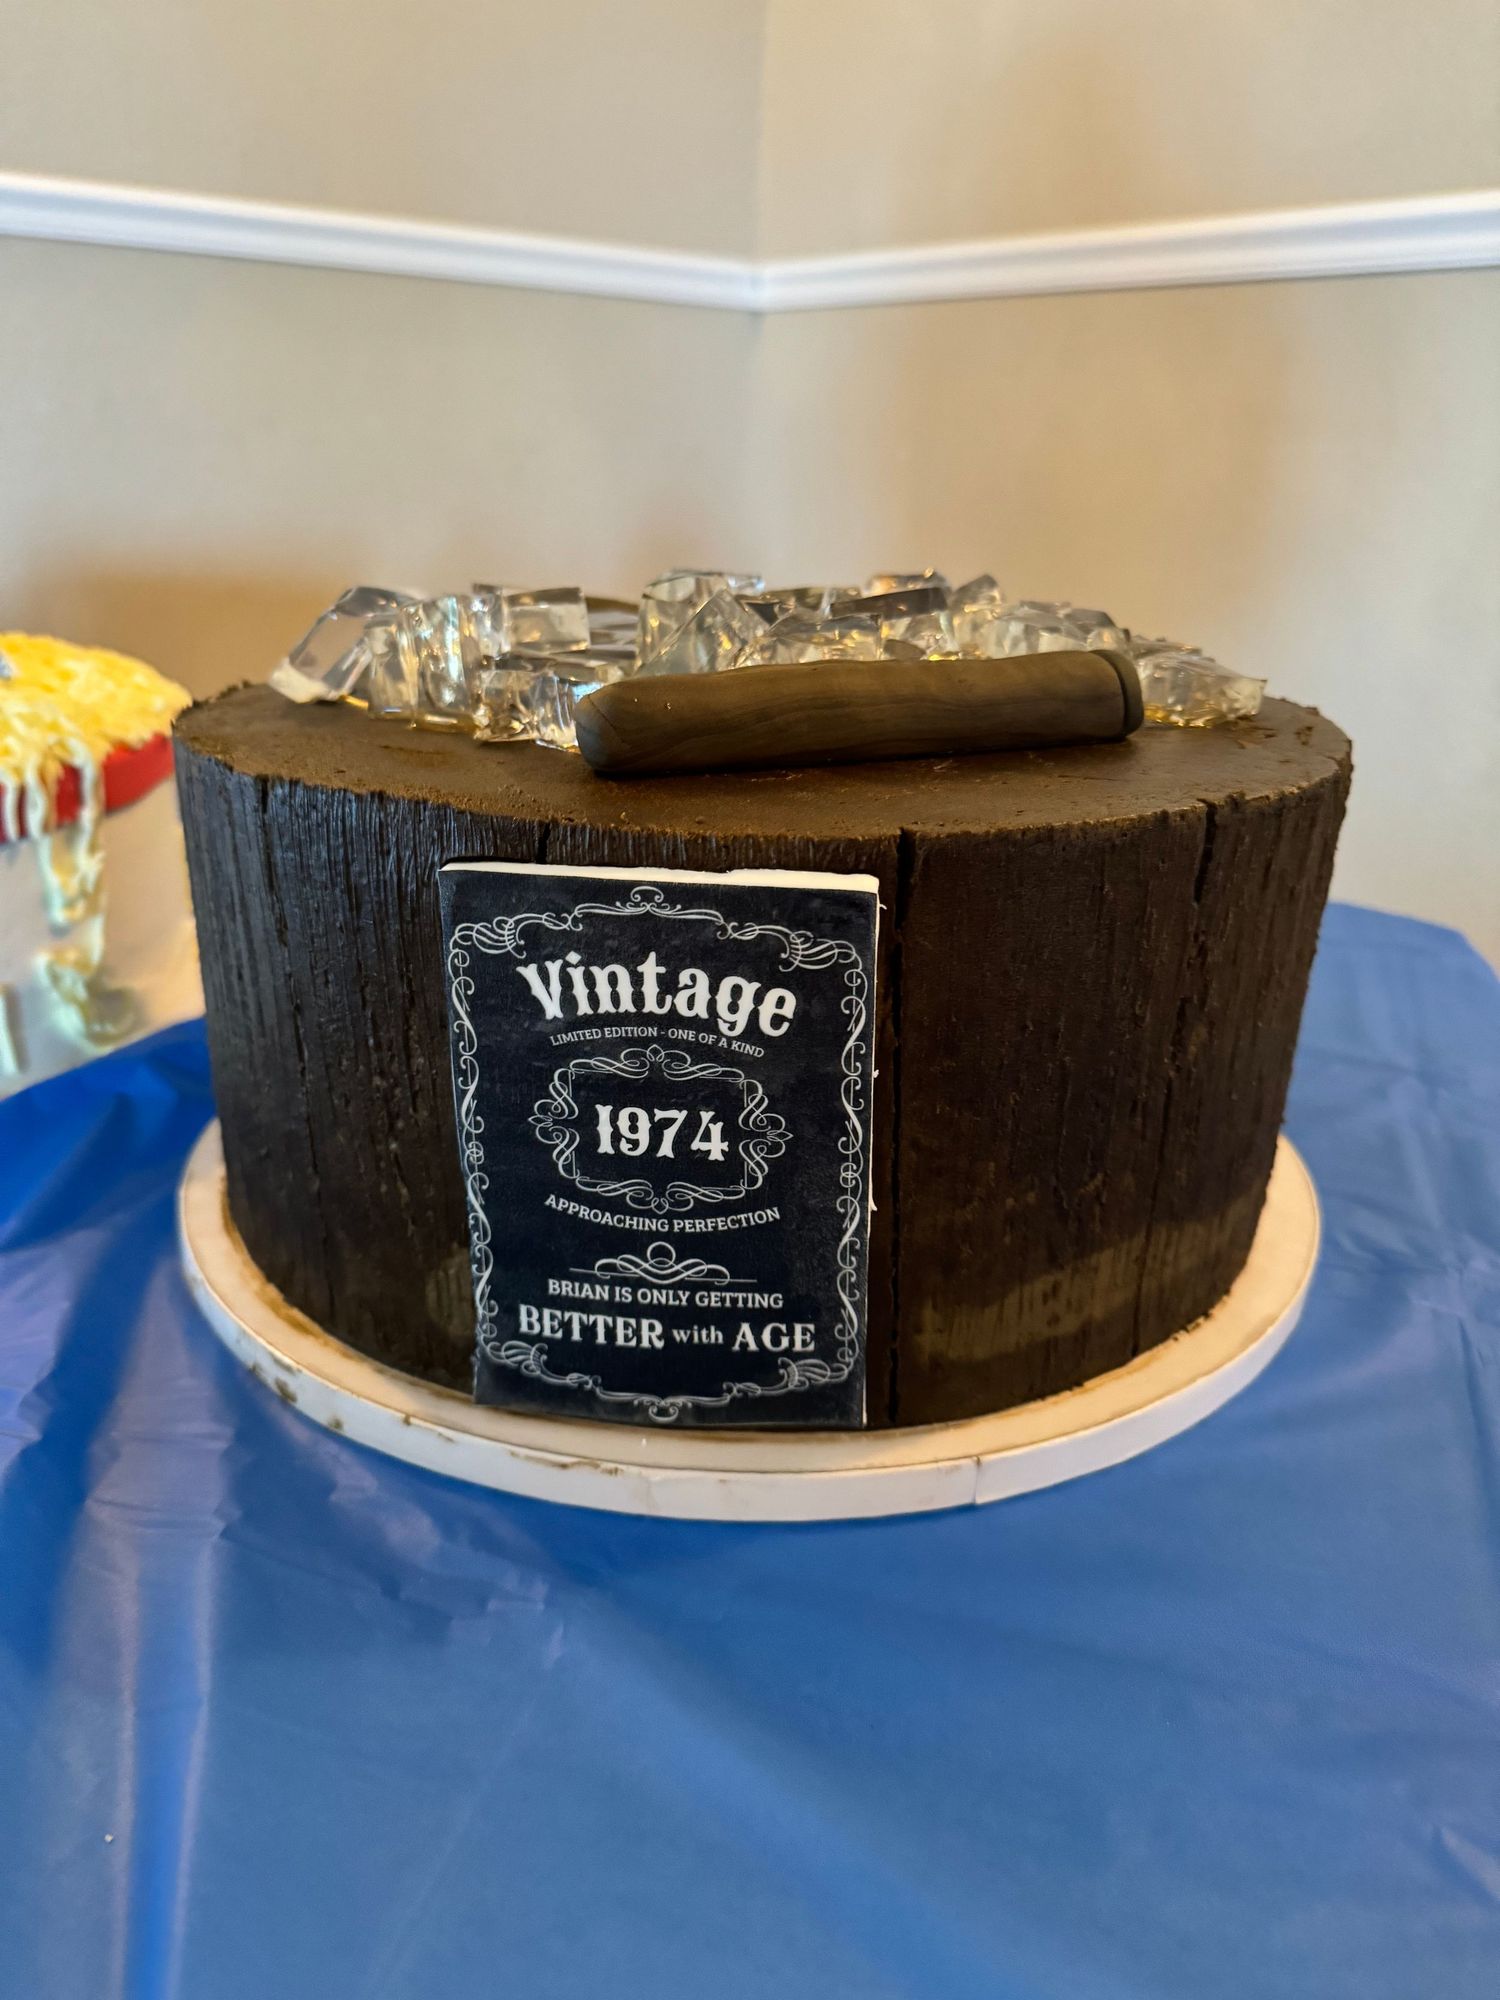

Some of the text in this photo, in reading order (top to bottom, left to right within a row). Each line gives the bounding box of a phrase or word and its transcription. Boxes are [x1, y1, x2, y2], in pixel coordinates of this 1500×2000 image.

[516, 951, 797, 1037] Vintage
[550, 1029, 602, 1046] LIMITED
[604, 1026, 658, 1038] EDITION
[668, 1028, 696, 1041] ONE
[698, 1033, 716, 1045] OF
[719, 1037, 730, 1048] A
[731, 1040, 764, 1058] KIND
[595, 1104, 729, 1161] 1974
[544, 1194, 780, 1232] APPROACHING PERFECTION
[548, 1279, 783, 1309] BRIAN IS ONLY GETTING
[518, 1303, 815, 1352] BETTER with AGE
